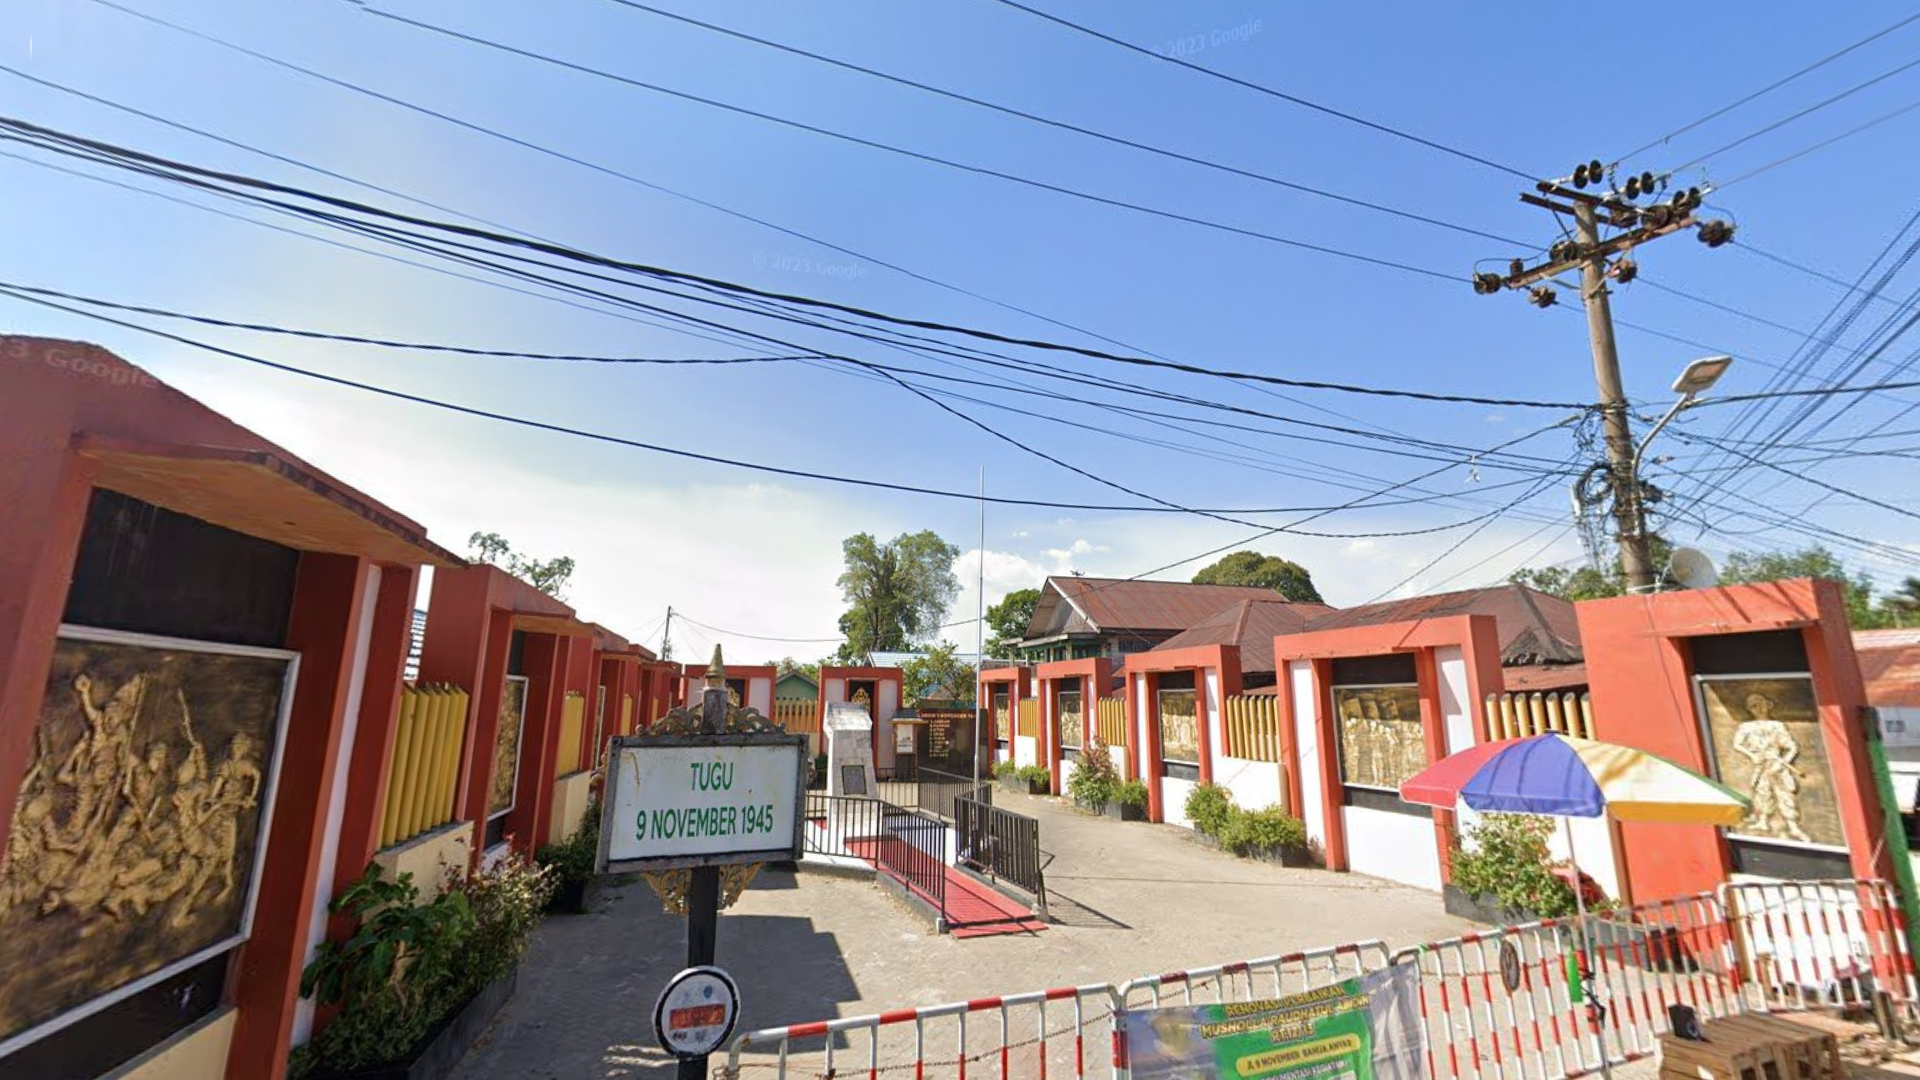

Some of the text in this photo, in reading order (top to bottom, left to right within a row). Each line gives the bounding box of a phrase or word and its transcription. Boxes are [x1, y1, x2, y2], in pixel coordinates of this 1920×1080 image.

[691, 762, 734, 791] TUGU
[636, 805, 773, 841] 9 NOVEMBER 1945
